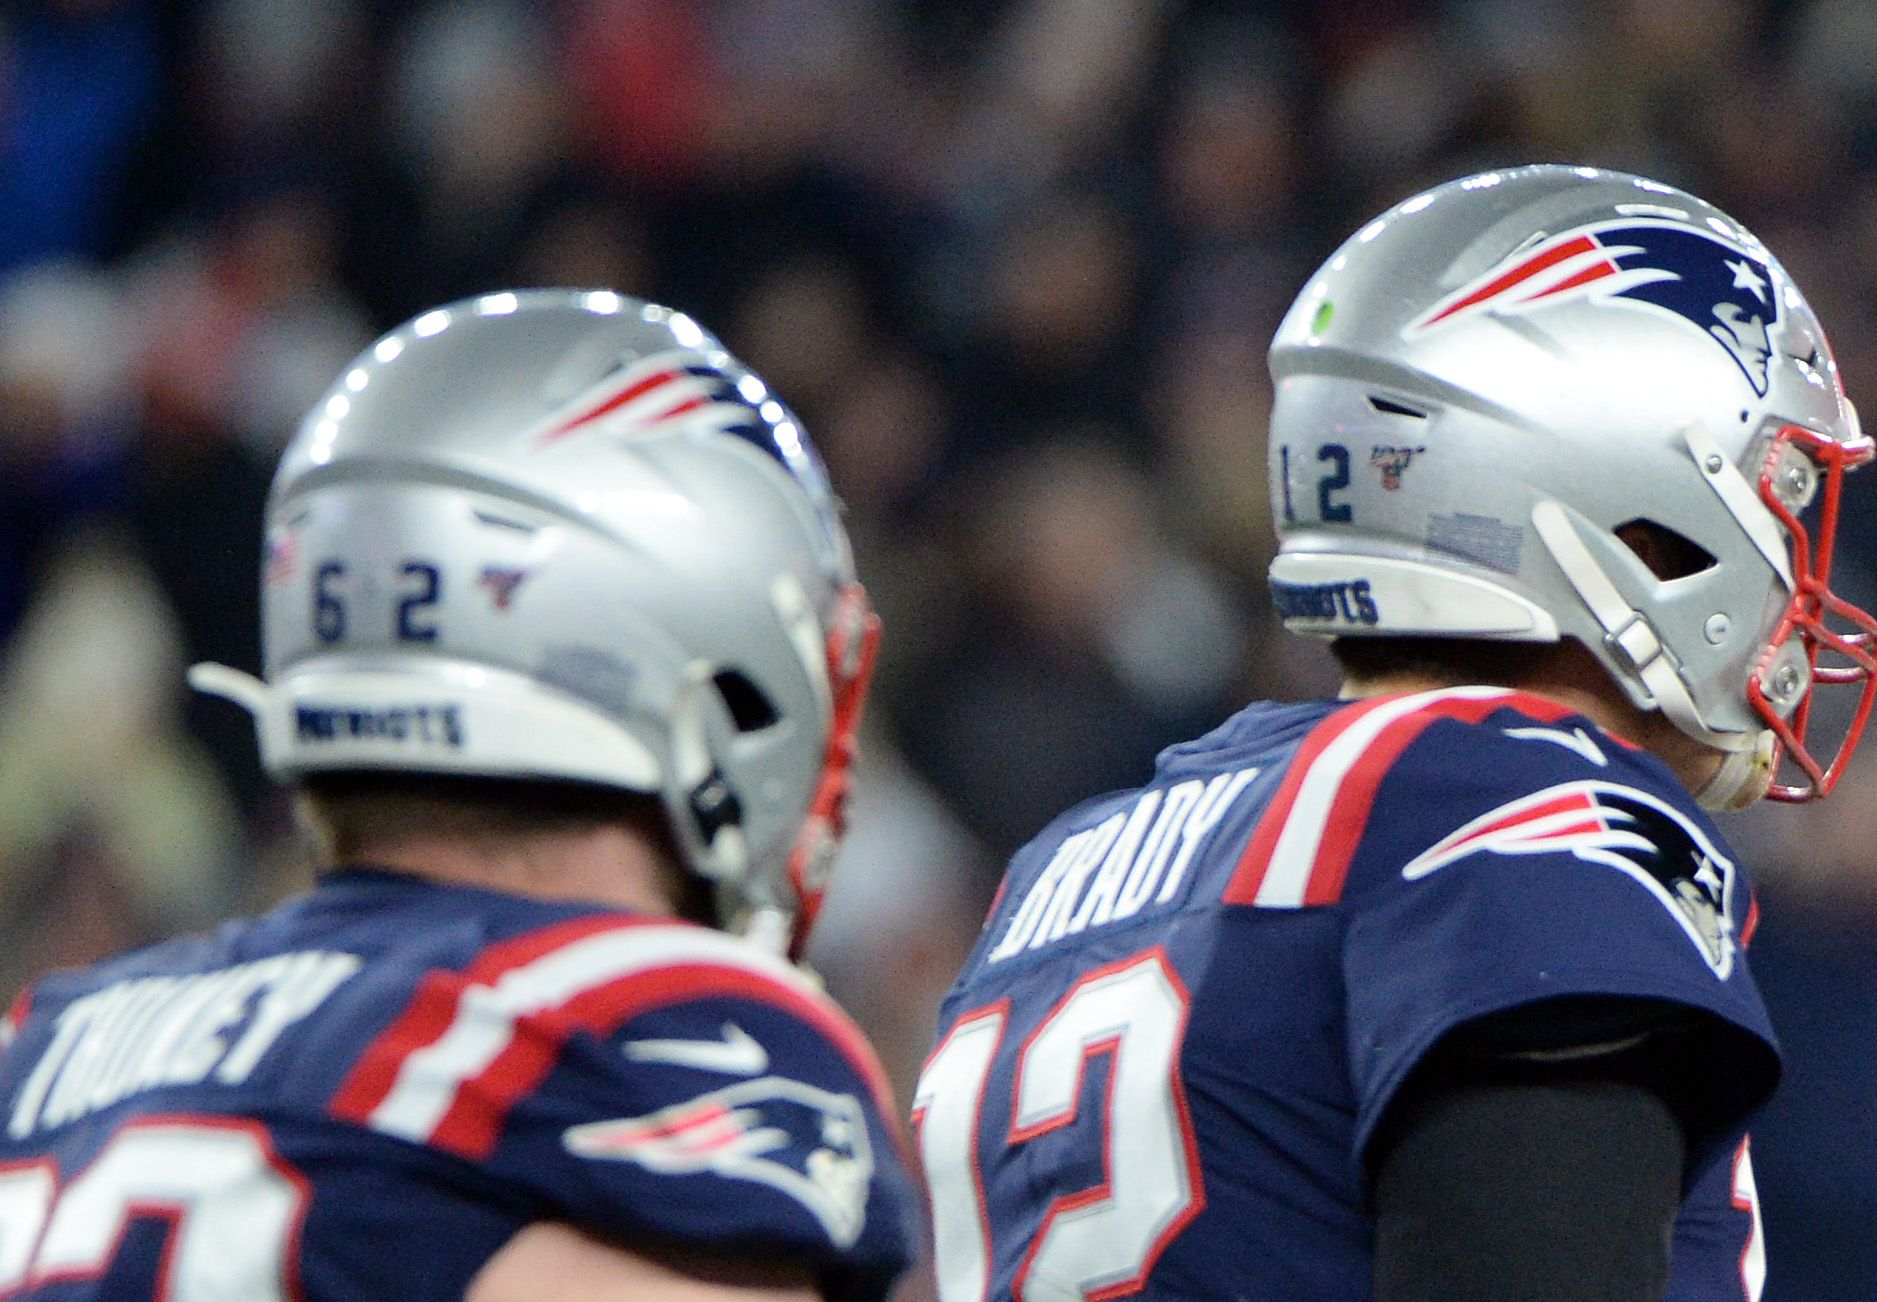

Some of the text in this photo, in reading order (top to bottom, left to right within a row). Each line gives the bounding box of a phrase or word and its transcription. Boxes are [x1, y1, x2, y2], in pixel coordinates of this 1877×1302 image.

[1281, 444, 1353, 522] 12
[313, 560, 440, 641] 62
[987, 767, 1261, 964] BRADY
